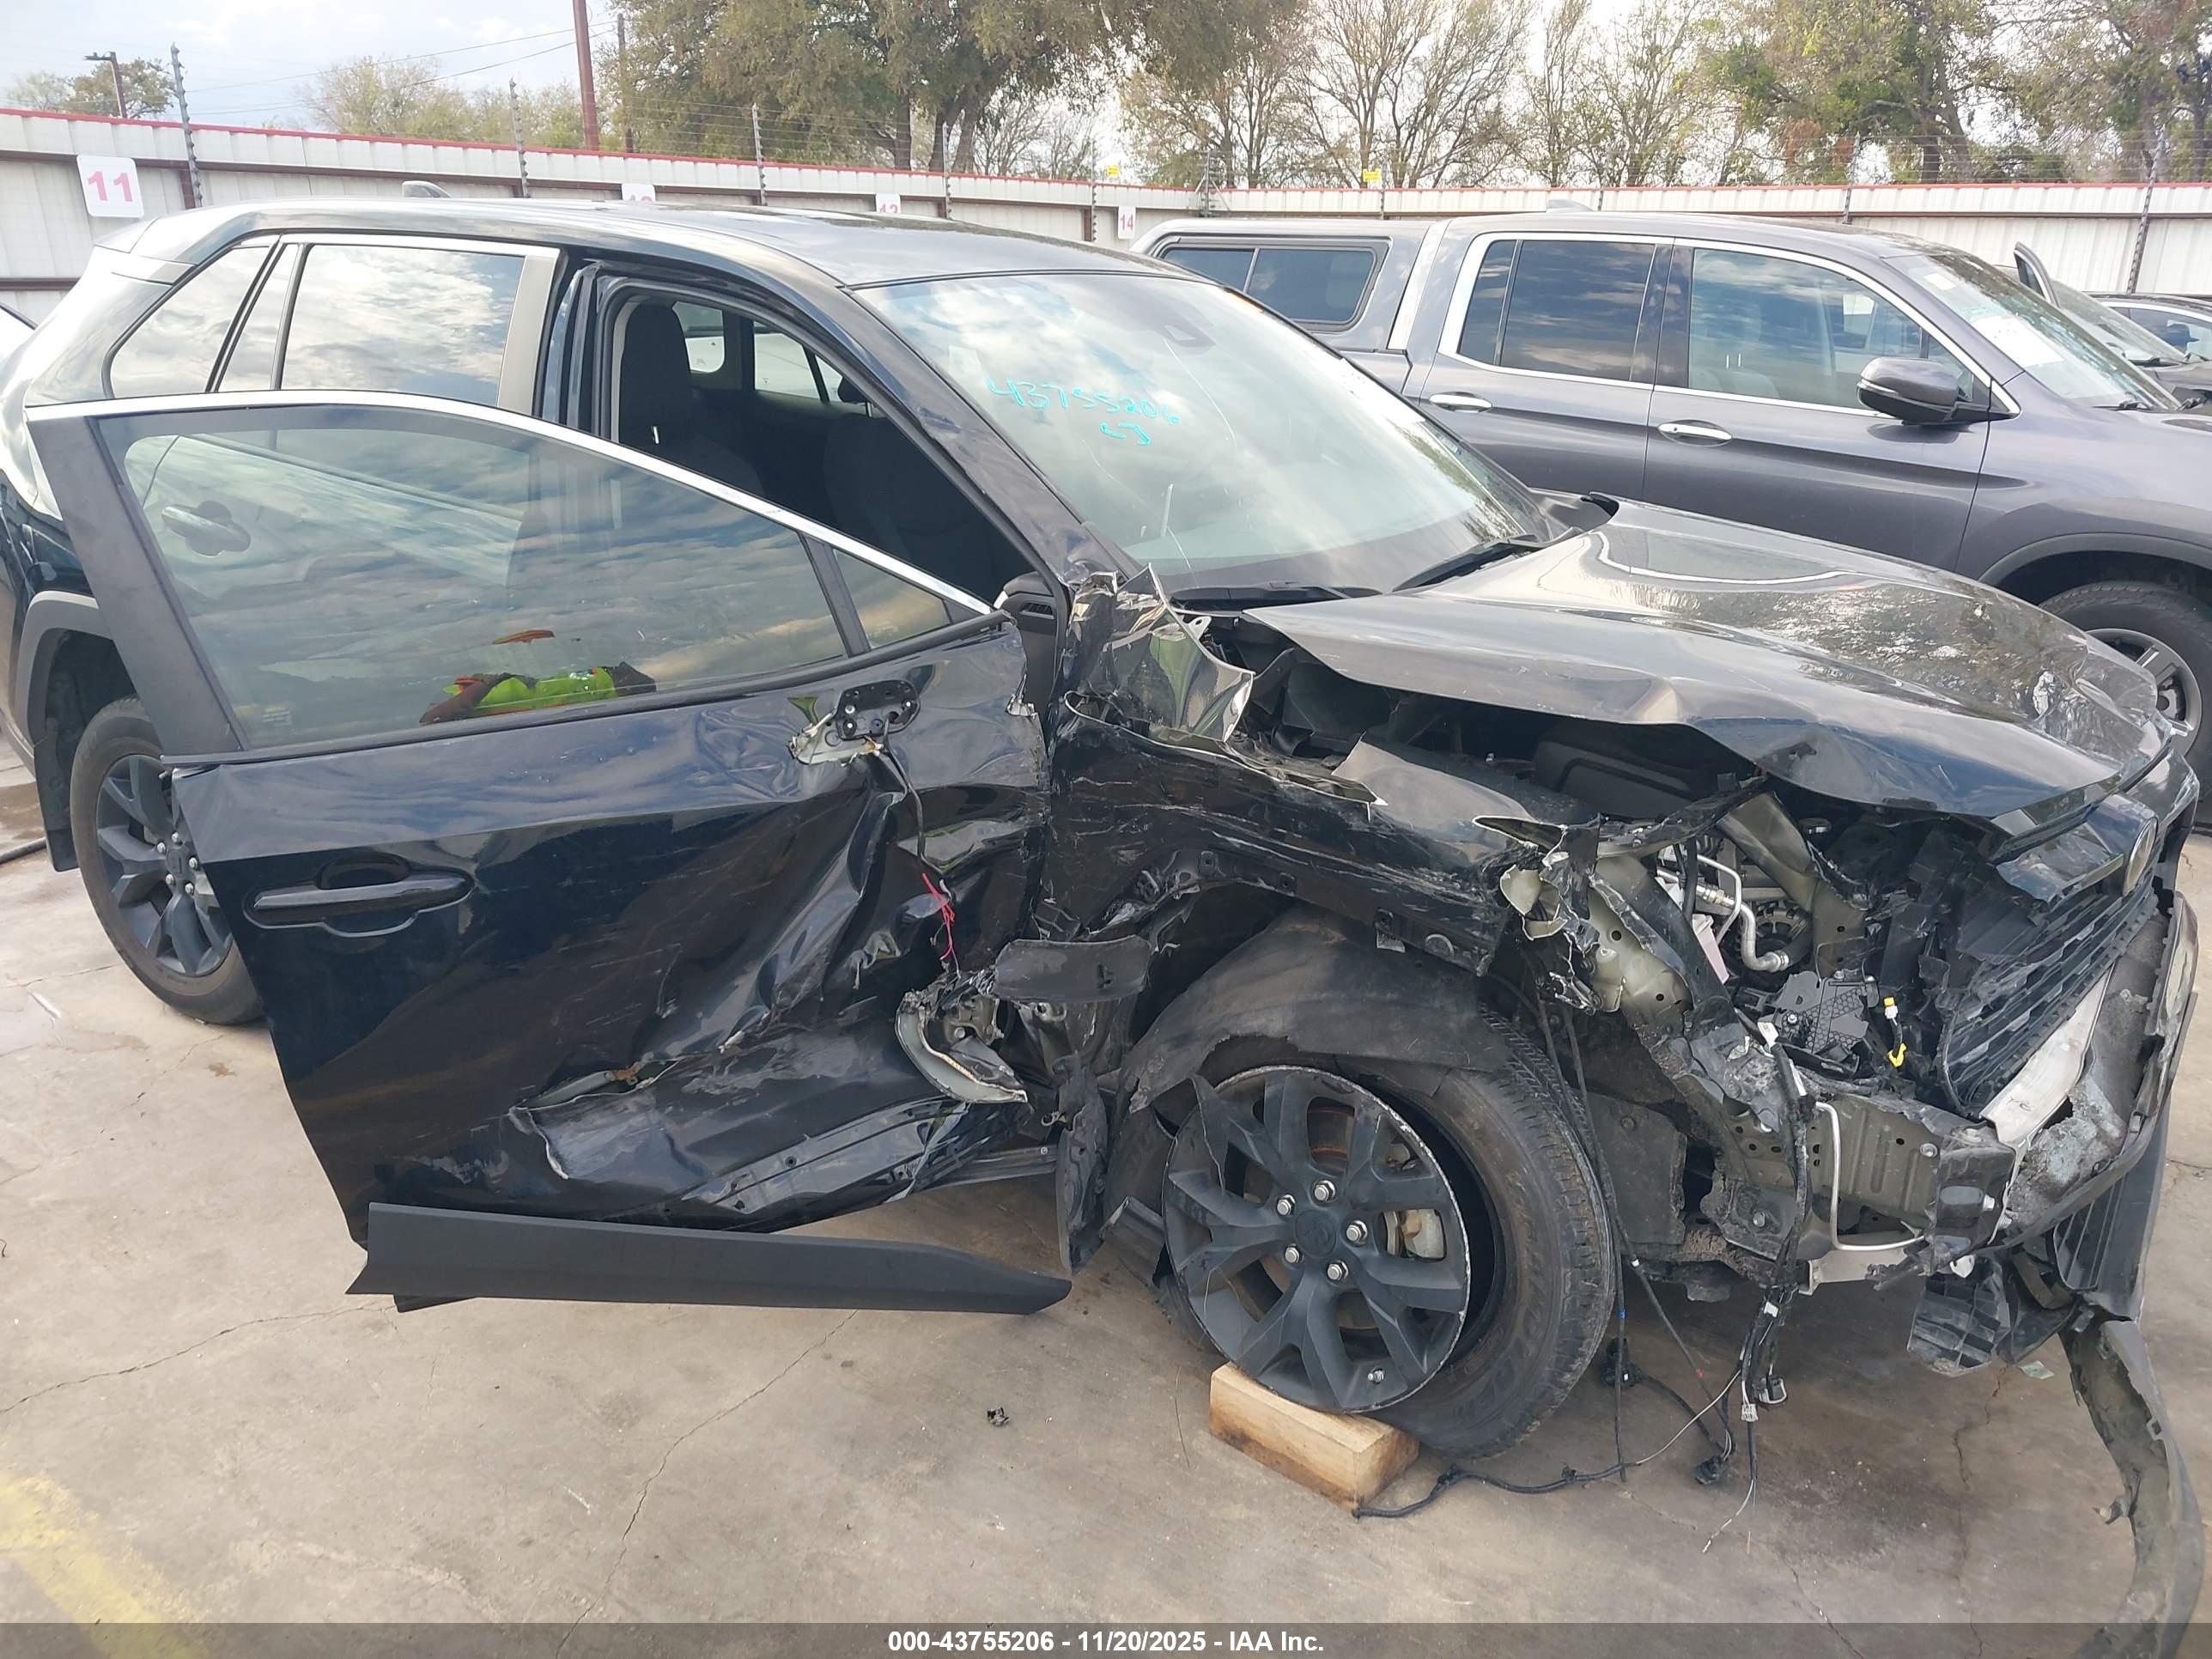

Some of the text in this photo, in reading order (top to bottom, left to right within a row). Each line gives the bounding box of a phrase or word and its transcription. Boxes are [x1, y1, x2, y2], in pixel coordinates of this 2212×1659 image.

[88, 171, 133, 203] 11
[1120, 213, 1134, 231] 14
[986, 379, 1181, 426] 43755206
